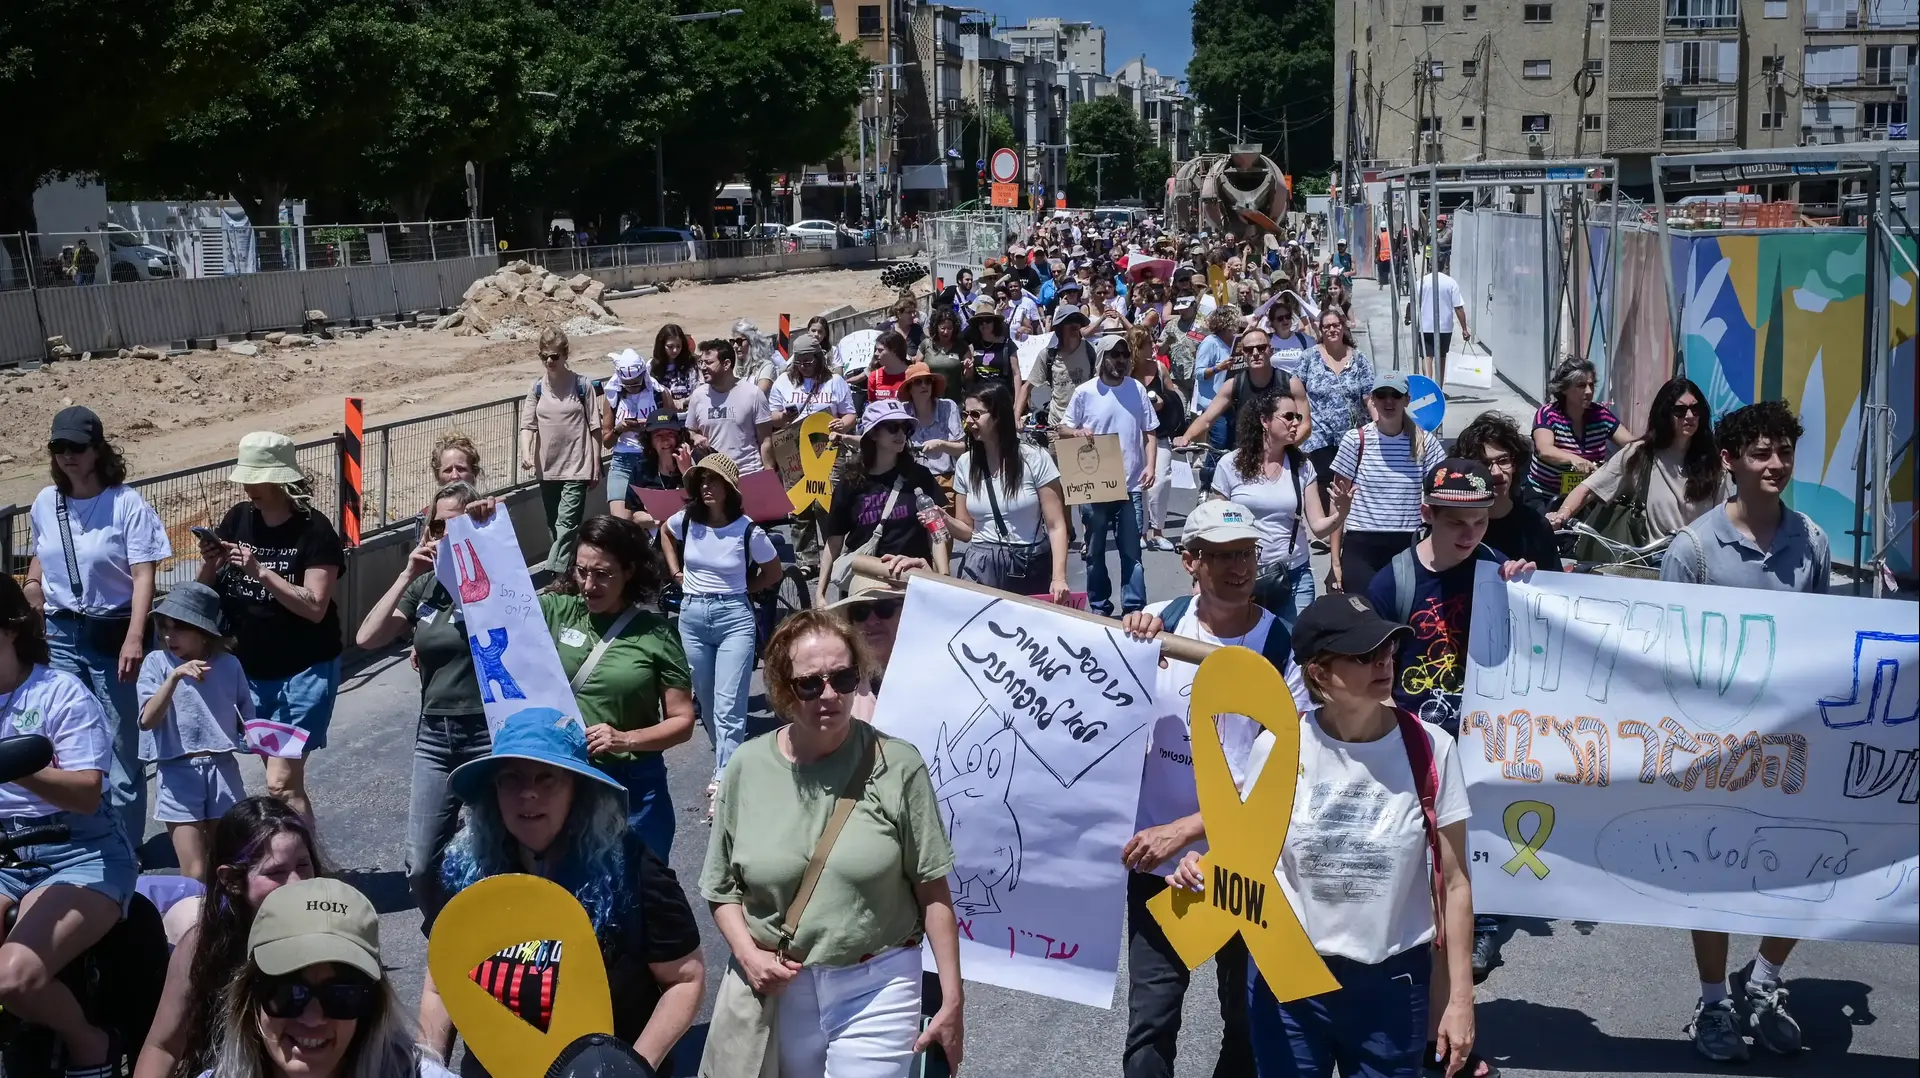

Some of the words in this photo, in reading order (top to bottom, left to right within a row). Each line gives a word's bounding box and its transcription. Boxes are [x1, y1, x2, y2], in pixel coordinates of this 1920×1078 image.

[805, 479, 827, 496] NOW.
[1101, 480, 1118, 489] שר
[504, 605, 532, 627] קורס
[988, 621, 1072, 682] למורות
[1057, 636, 1134, 706] תוספת
[1061, 711, 1108, 743] ולא
[1462, 708, 1611, 788] הציבורי
[1617, 716, 1809, 795] המגזר
[1472, 850, 1489, 863] 59
[1805, 848, 1860, 878] לא
[305, 900, 349, 915] HOLY
[1213, 864, 1268, 930] NOW.
[1007, 926, 1080, 960] עדיין
